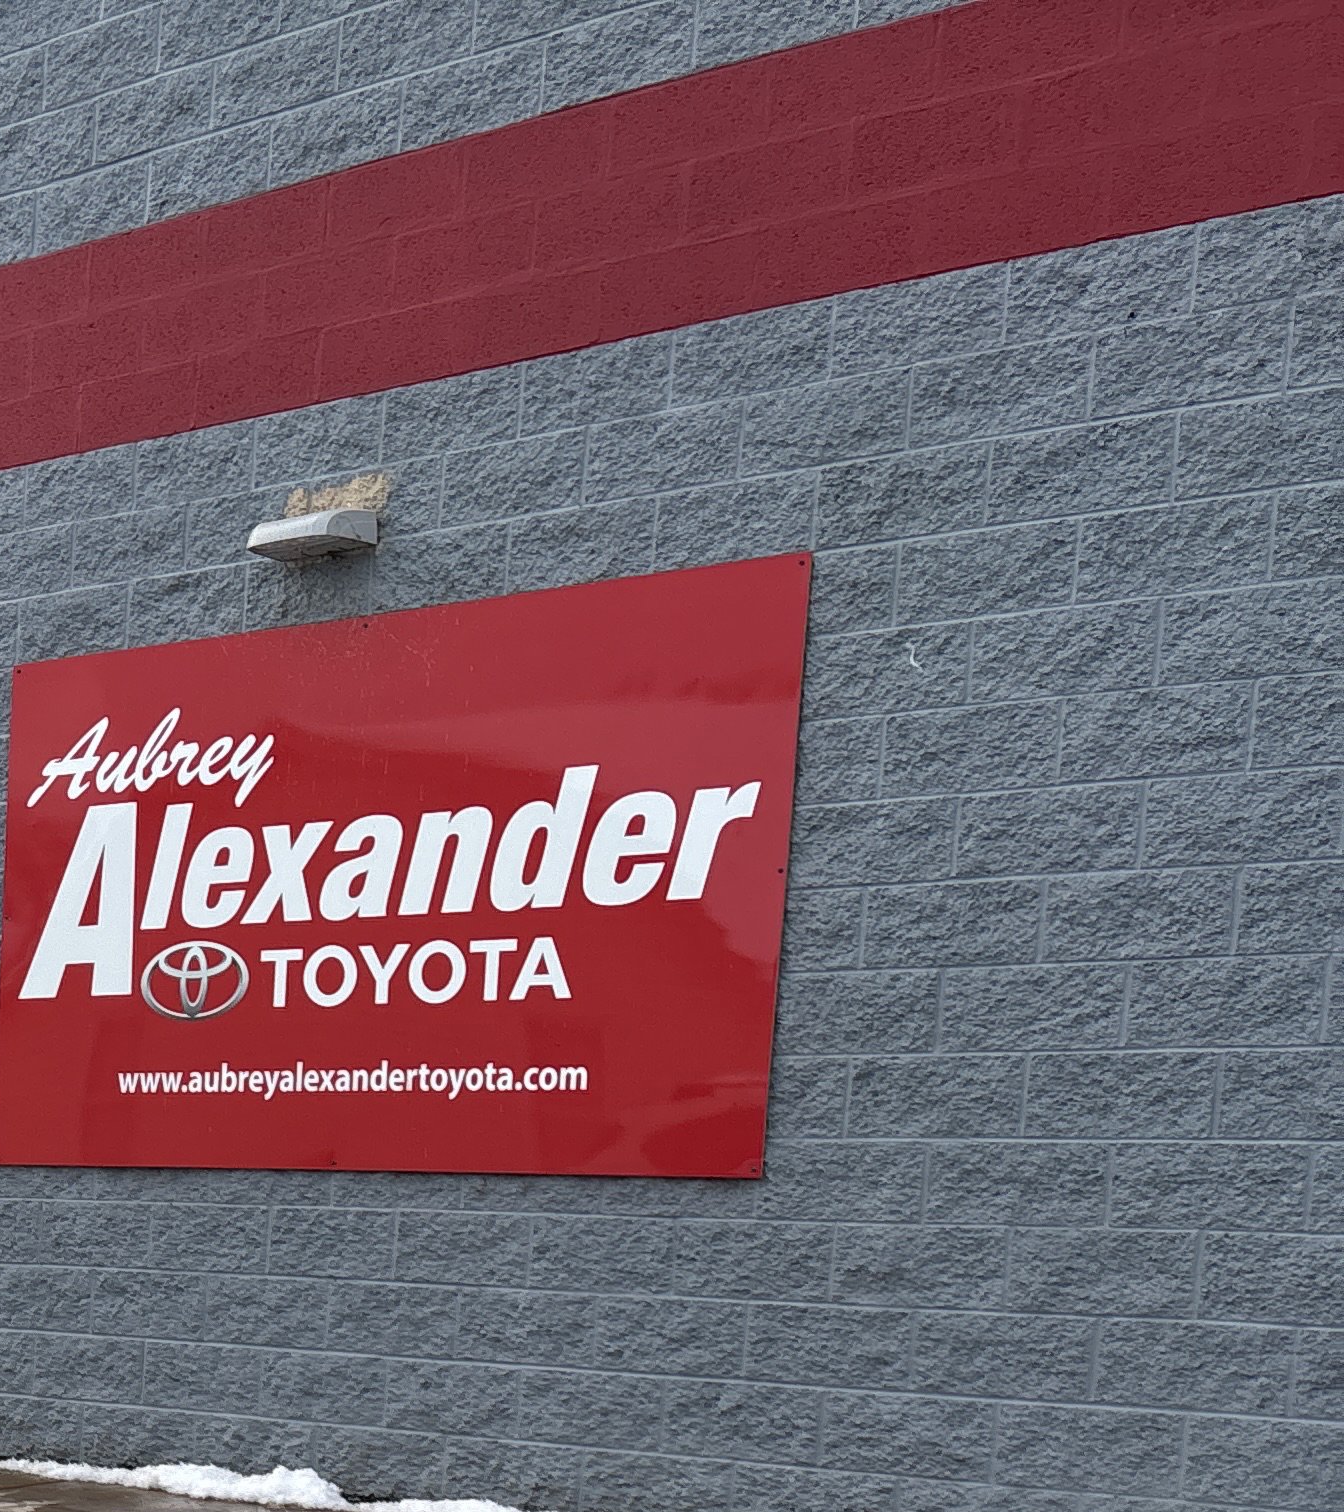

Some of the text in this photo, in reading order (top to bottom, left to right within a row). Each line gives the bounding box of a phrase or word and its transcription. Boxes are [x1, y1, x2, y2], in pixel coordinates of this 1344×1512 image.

[28, 708, 275, 808] Aubrey
[18, 765, 762, 1000] Alexander
[261, 937, 572, 1008] TOYOTA
[118, 1062, 588, 1101] www.aubreyalexandertoyota.com
